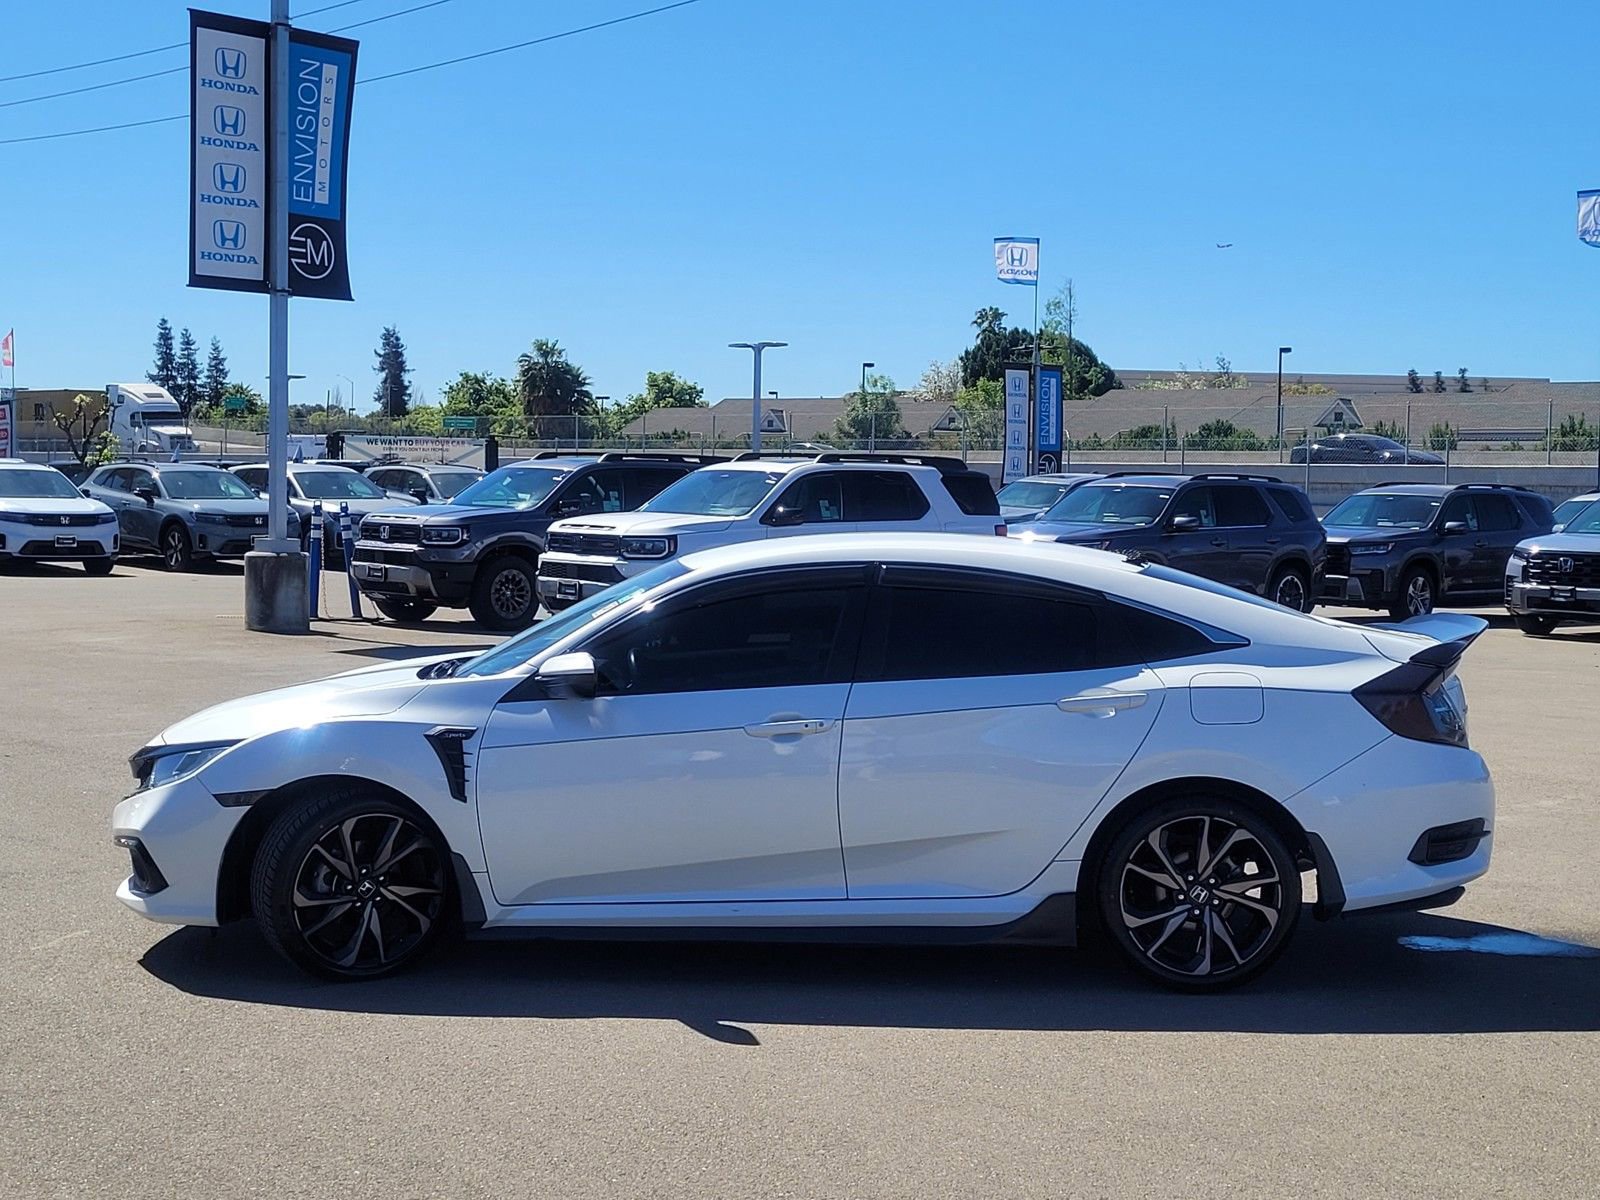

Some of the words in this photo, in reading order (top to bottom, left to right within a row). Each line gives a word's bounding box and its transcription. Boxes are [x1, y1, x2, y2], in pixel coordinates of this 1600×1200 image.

[200, 78, 260, 96] HONDA
[293, 58, 320, 202] ENVISION
[318, 77, 333, 193] MOTORS
[200, 136, 260, 152] HONDA
[200, 193, 260, 209] HONDA
[200, 251, 260, 265] HONDA
[1040, 376, 1050, 445] ENVISION
[366, 438, 379, 446] WE
[380, 438, 402, 446] WANT
[404, 438, 414, 446] TO
[430, 439, 450, 447] YOUR
